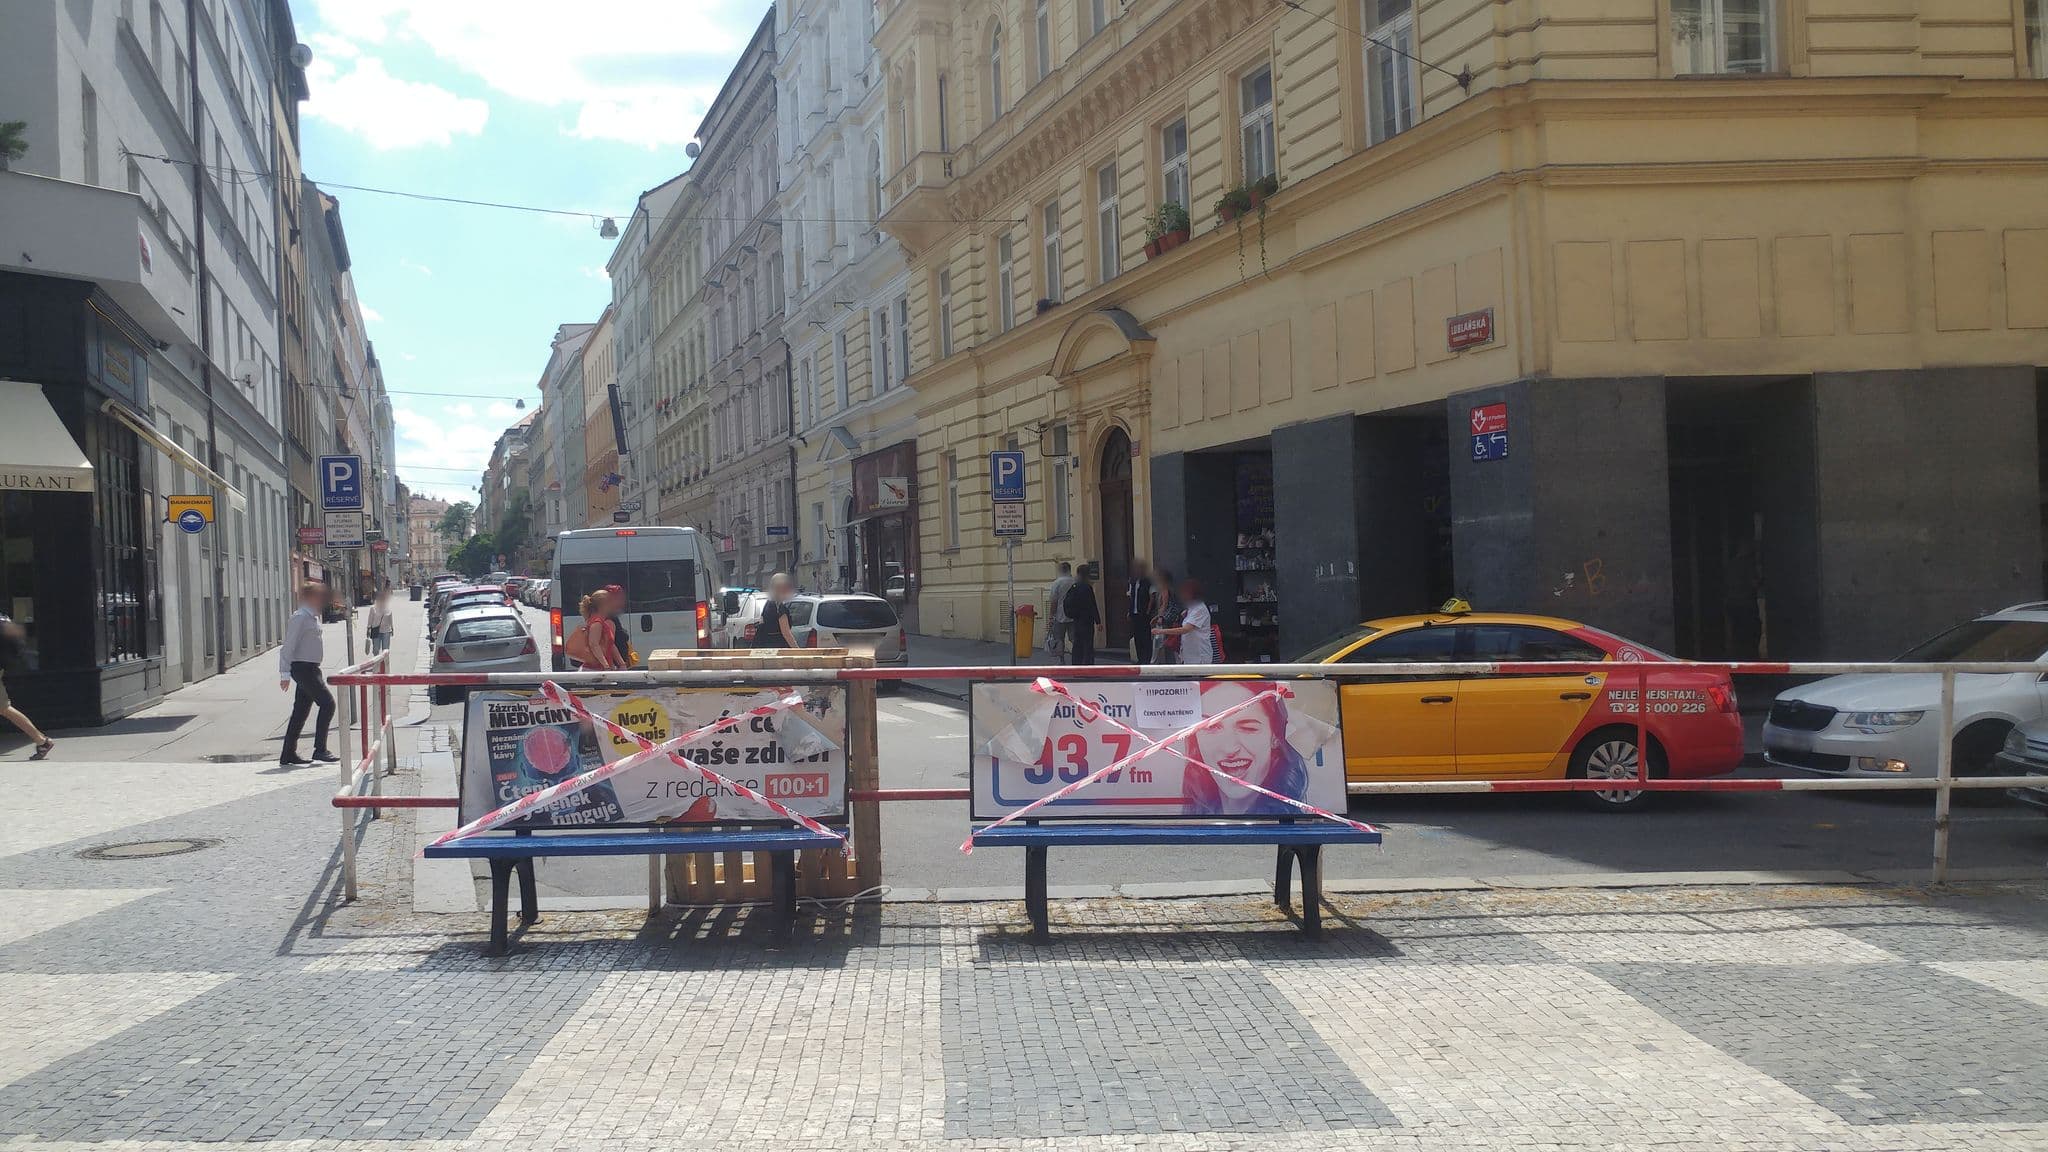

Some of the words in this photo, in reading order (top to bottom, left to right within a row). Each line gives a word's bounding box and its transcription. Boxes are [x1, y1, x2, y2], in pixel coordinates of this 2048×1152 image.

[488, 703, 529, 713] Zázraky
[1654, 703, 1679, 714] 000
[1682, 703, 1707, 713] 226
[489, 707, 573, 729] MEDICÍNY
[618, 708, 657, 726] Nový
[494, 752, 515, 760] kávy
[679, 740, 739, 765] vaše
[1129, 767, 1153, 783] fm
[646, 782, 659, 798] z
[768, 778, 823, 796] 100+1
